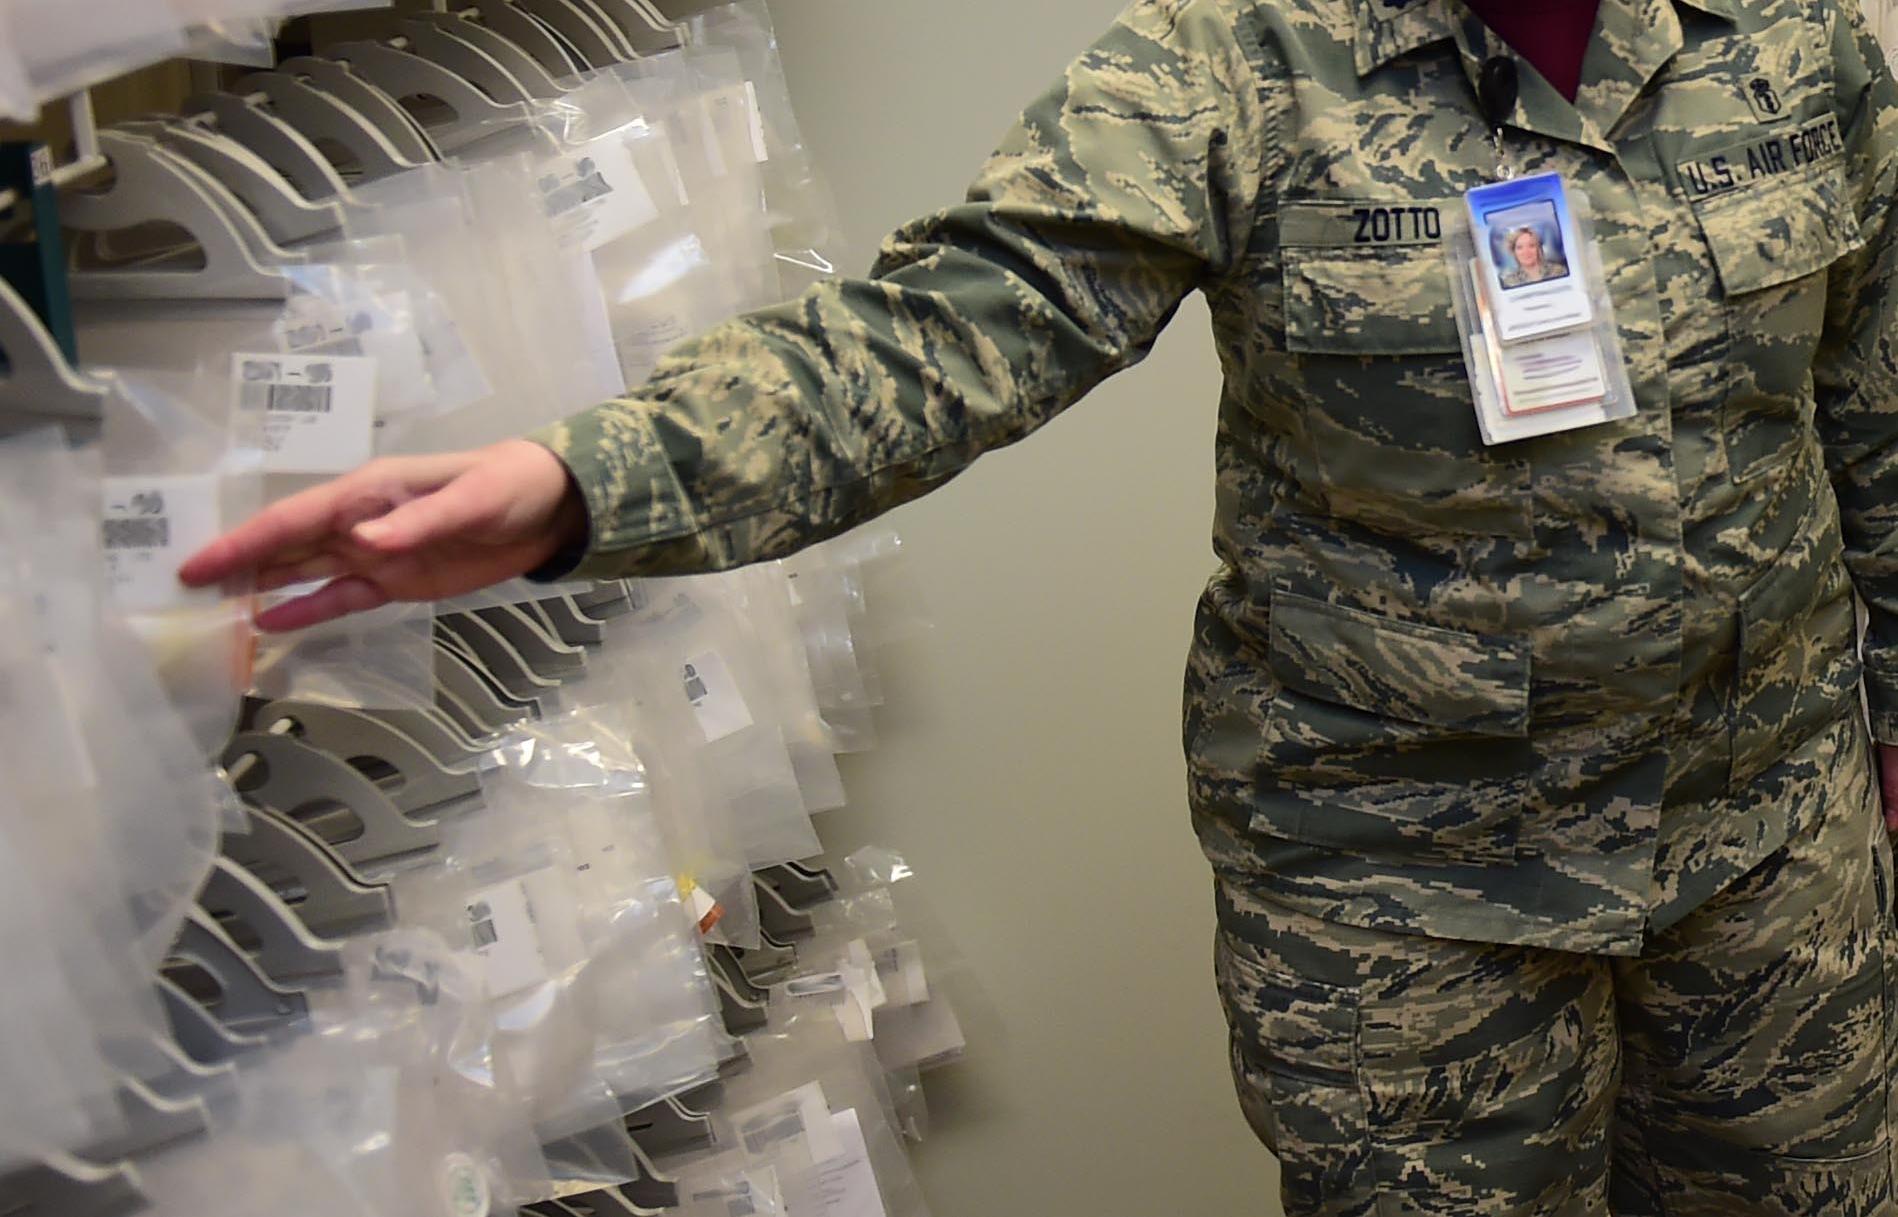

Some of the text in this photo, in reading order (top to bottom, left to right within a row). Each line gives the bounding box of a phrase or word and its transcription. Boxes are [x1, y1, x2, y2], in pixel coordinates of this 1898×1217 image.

[1687, 121, 1841, 194] U.S. AIR FORCE
[1353, 207, 1441, 243] ZOTTO
